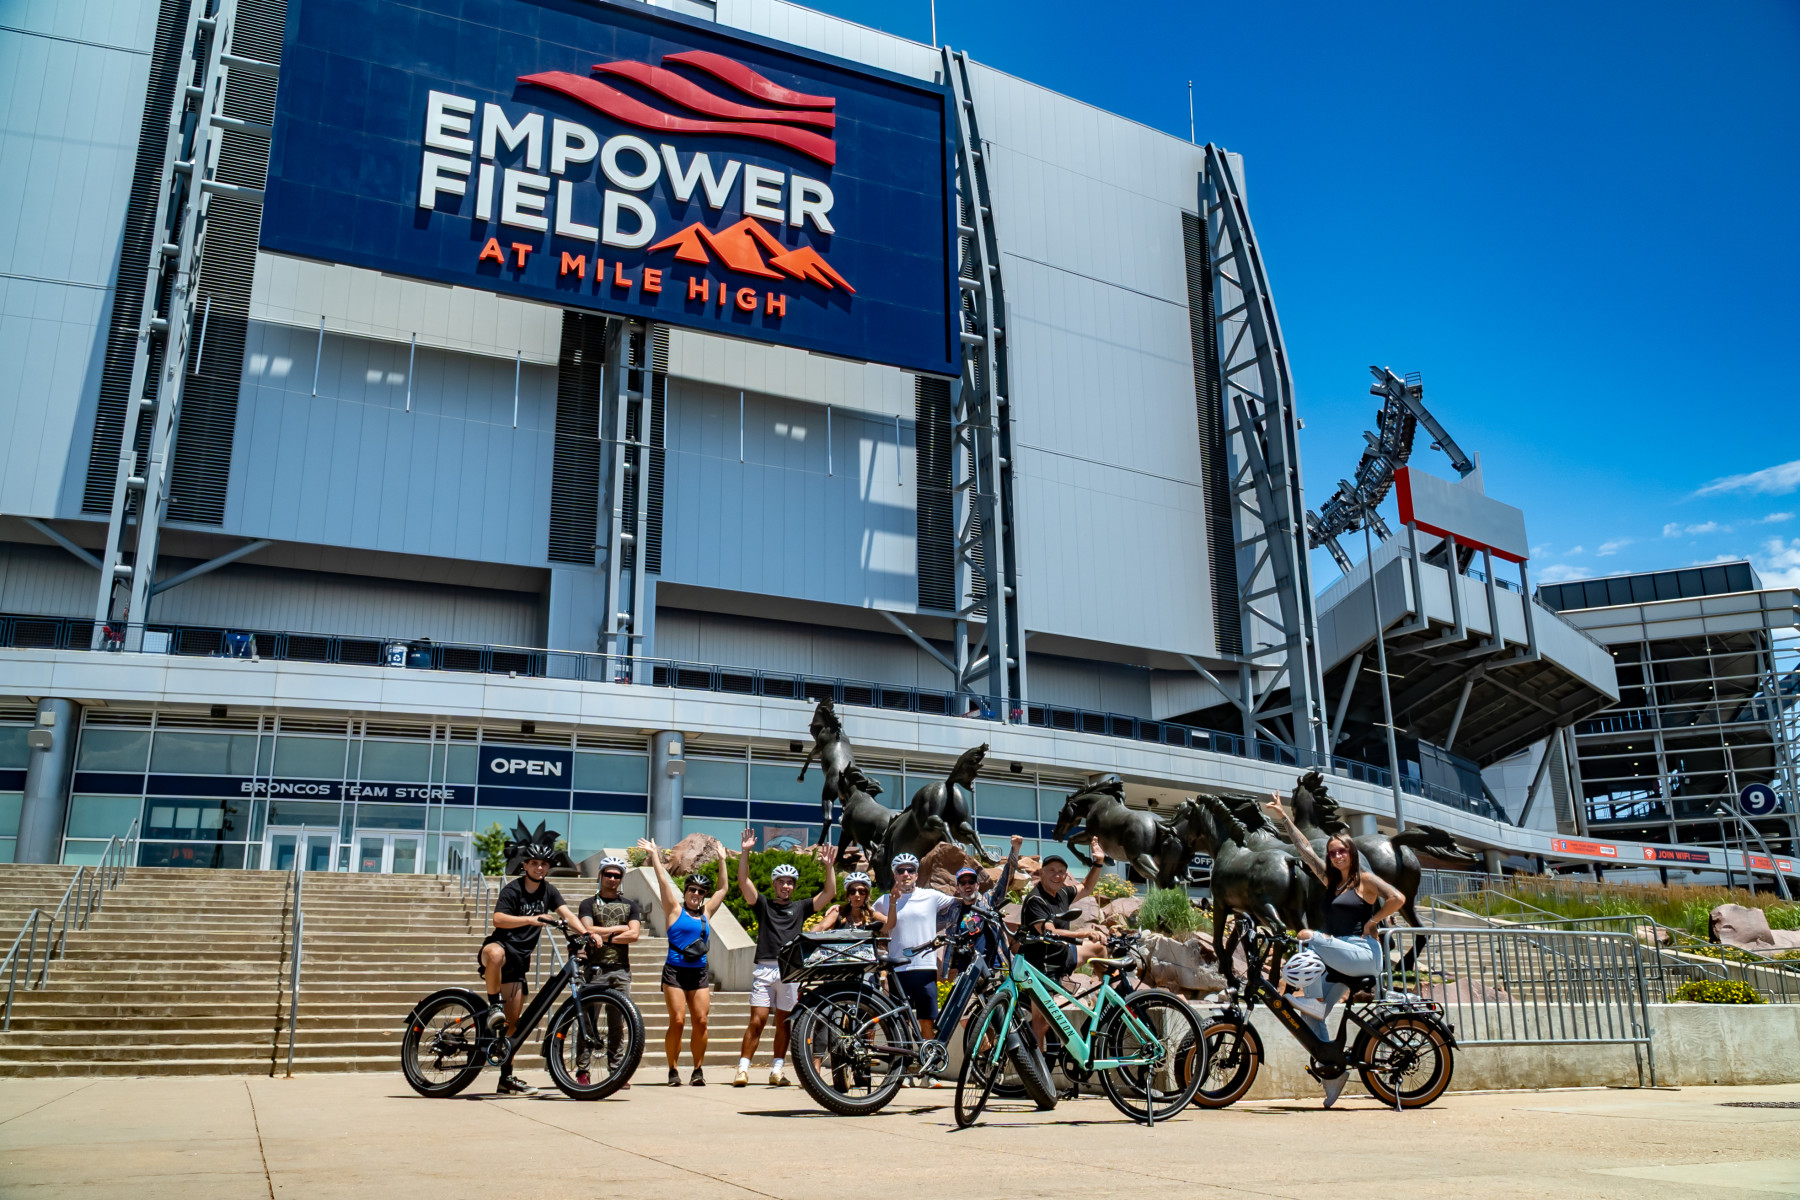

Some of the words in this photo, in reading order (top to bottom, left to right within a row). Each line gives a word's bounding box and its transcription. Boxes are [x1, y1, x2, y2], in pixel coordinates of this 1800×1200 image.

[425, 89, 835, 234] EMPOWER
[419, 150, 657, 248] FIELD
[479, 237, 533, 268] AT
[560, 251, 663, 293] MILE
[688, 276, 787, 317] HIGH
[490, 757, 562, 777] OPEN
[241, 781, 331, 795] BRONCOS
[338, 785, 388, 798] TEAM
[395, 787, 455, 800] STORE
[1749, 791, 1765, 809] 9
[1658, 850, 1675, 860] JOIN
[1675, 851, 1691, 861] WIFI
[1043, 999, 1075, 1037] AVENTON
